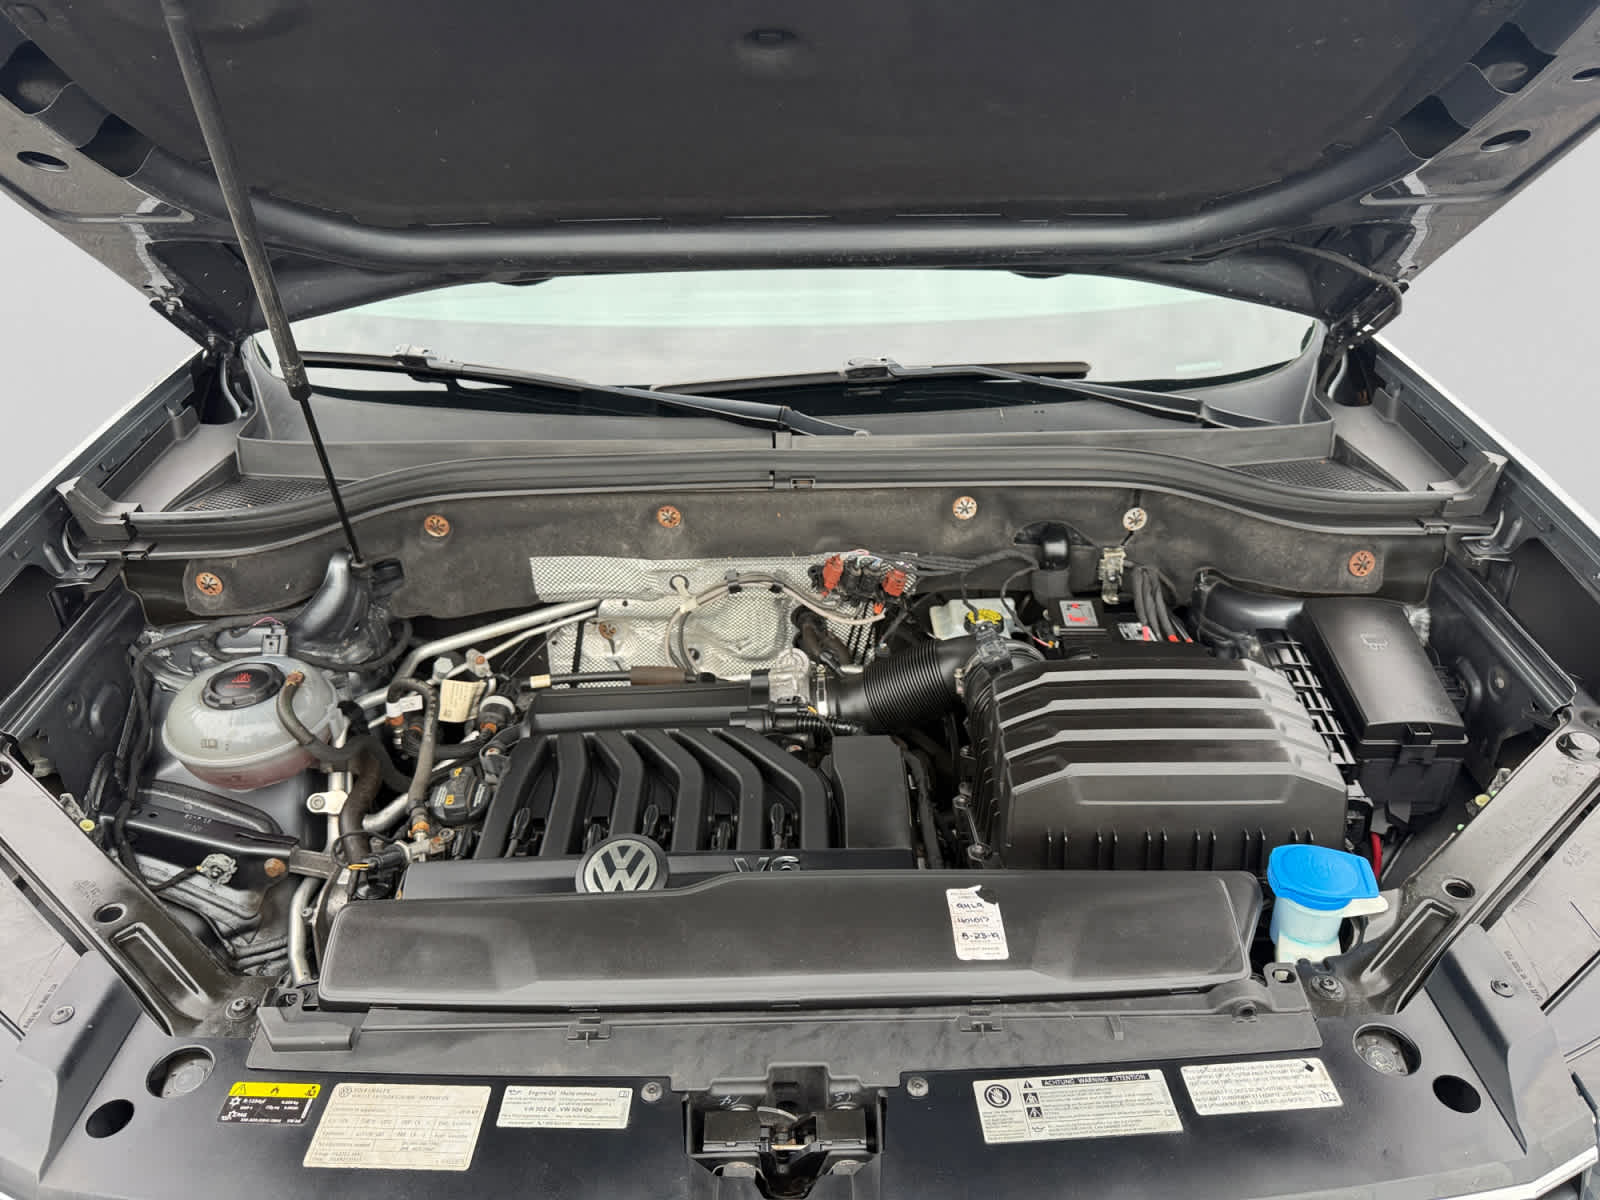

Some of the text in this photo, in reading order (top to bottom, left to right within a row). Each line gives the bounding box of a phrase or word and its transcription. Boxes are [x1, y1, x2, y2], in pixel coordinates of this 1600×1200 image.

[584, 839, 657, 892] VW
[1044, 1073, 1147, 1086] ACHTUNG WARNING ATTENTION
